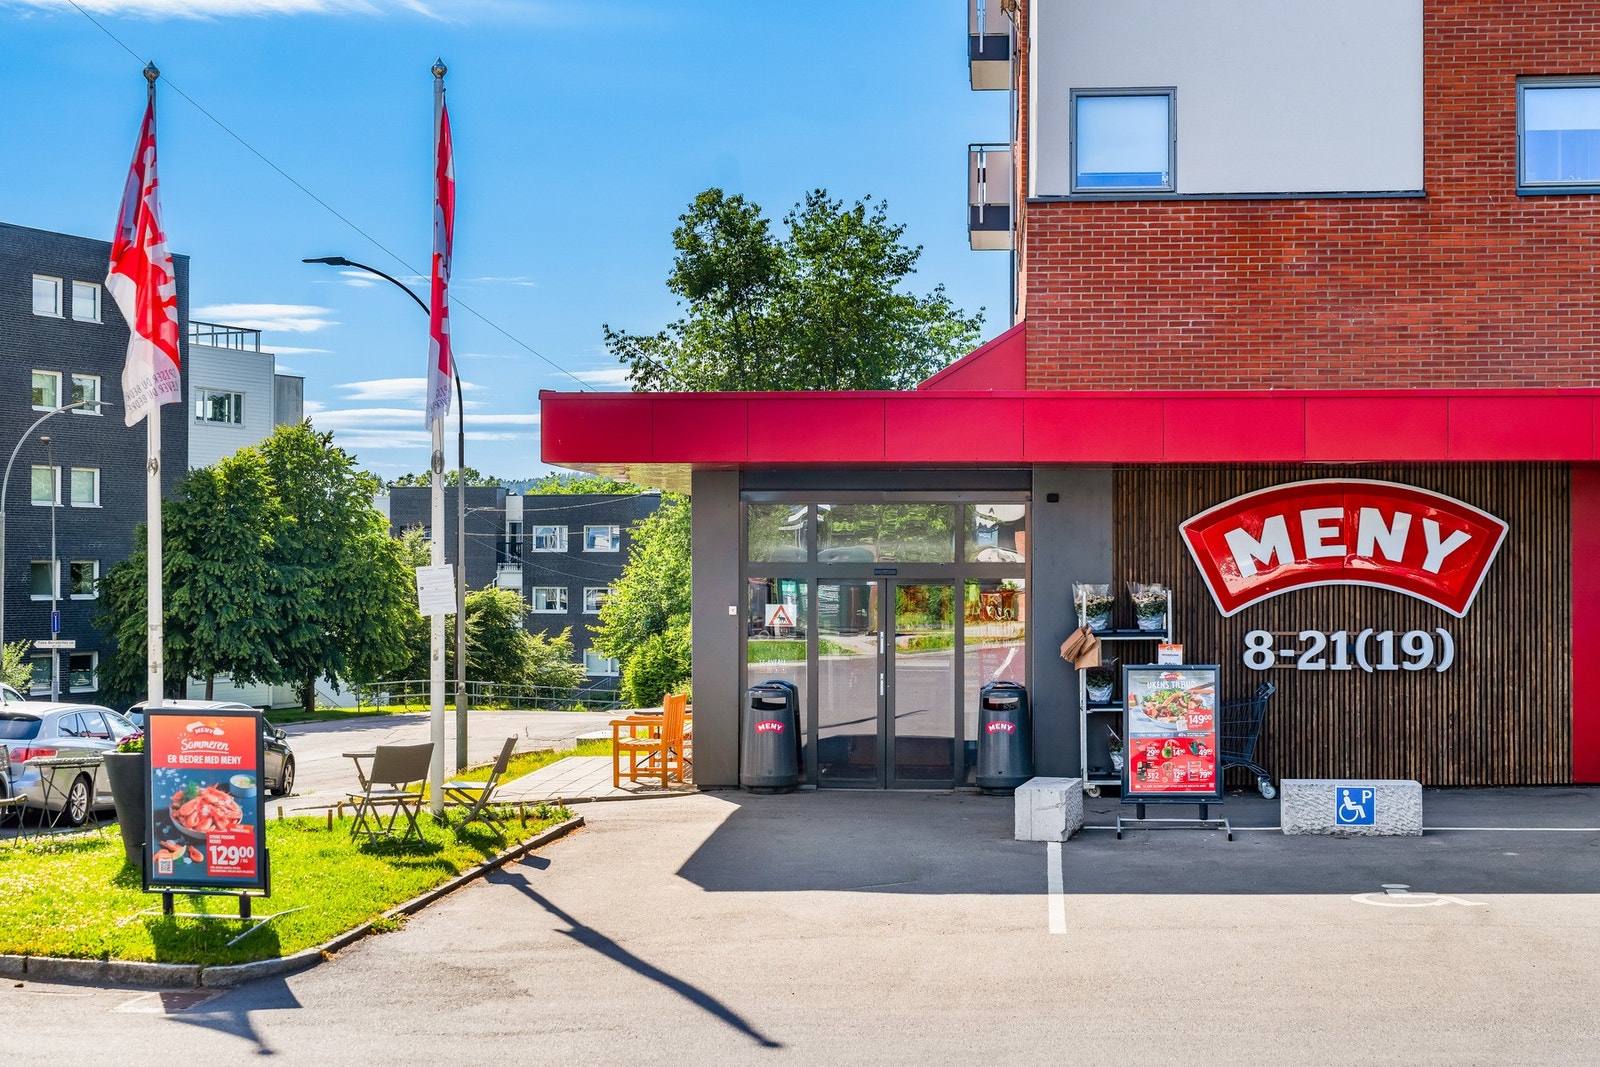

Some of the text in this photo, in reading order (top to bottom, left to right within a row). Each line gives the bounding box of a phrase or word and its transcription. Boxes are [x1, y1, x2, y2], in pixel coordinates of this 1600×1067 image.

[1223, 507, 1472, 578] MENY
[1242, 628, 1455, 673] 8-21(19)
[1147, 681, 1170, 689] UKENS
[194, 726, 214, 734] MENY
[757, 722, 783, 731] MENY
[988, 723, 1013, 732] MENY
[181, 739, 229, 750] Sommeren
[167, 754, 242, 765] ER BEDRE MED MENY
[1362, 790, 1372, 804] P
